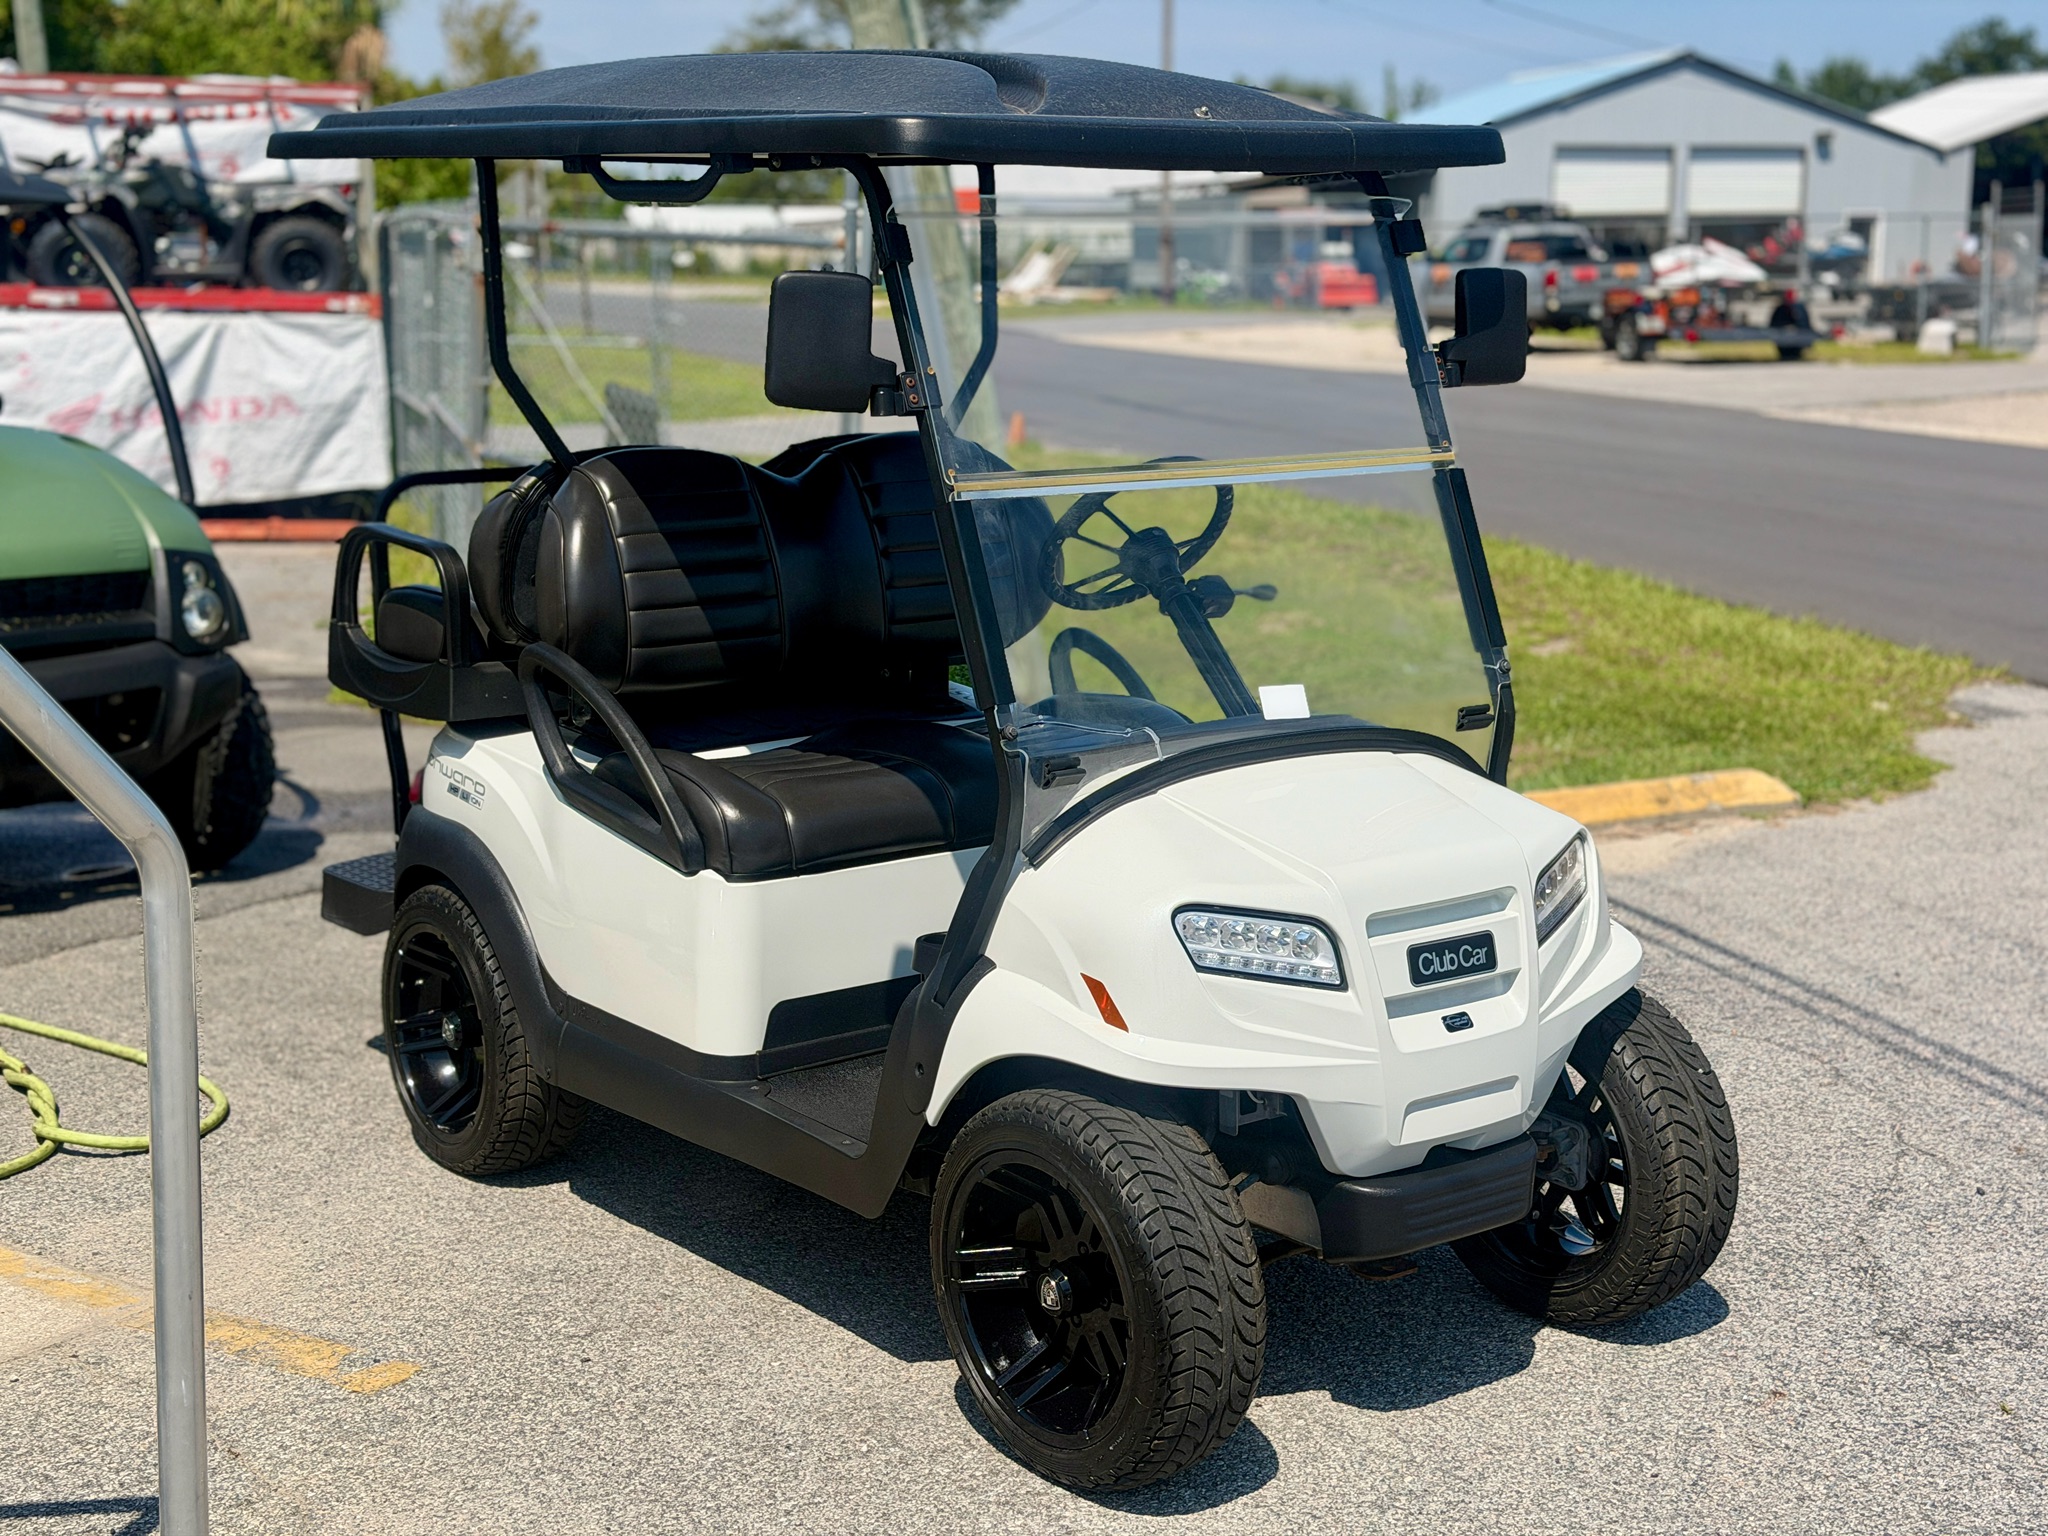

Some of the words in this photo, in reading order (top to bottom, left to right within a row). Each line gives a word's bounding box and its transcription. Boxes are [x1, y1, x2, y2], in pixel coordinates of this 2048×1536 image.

[108, 393, 302, 431] HONDA
[1418, 949, 1458, 975] Club
[1459, 944, 1488, 967] Car
